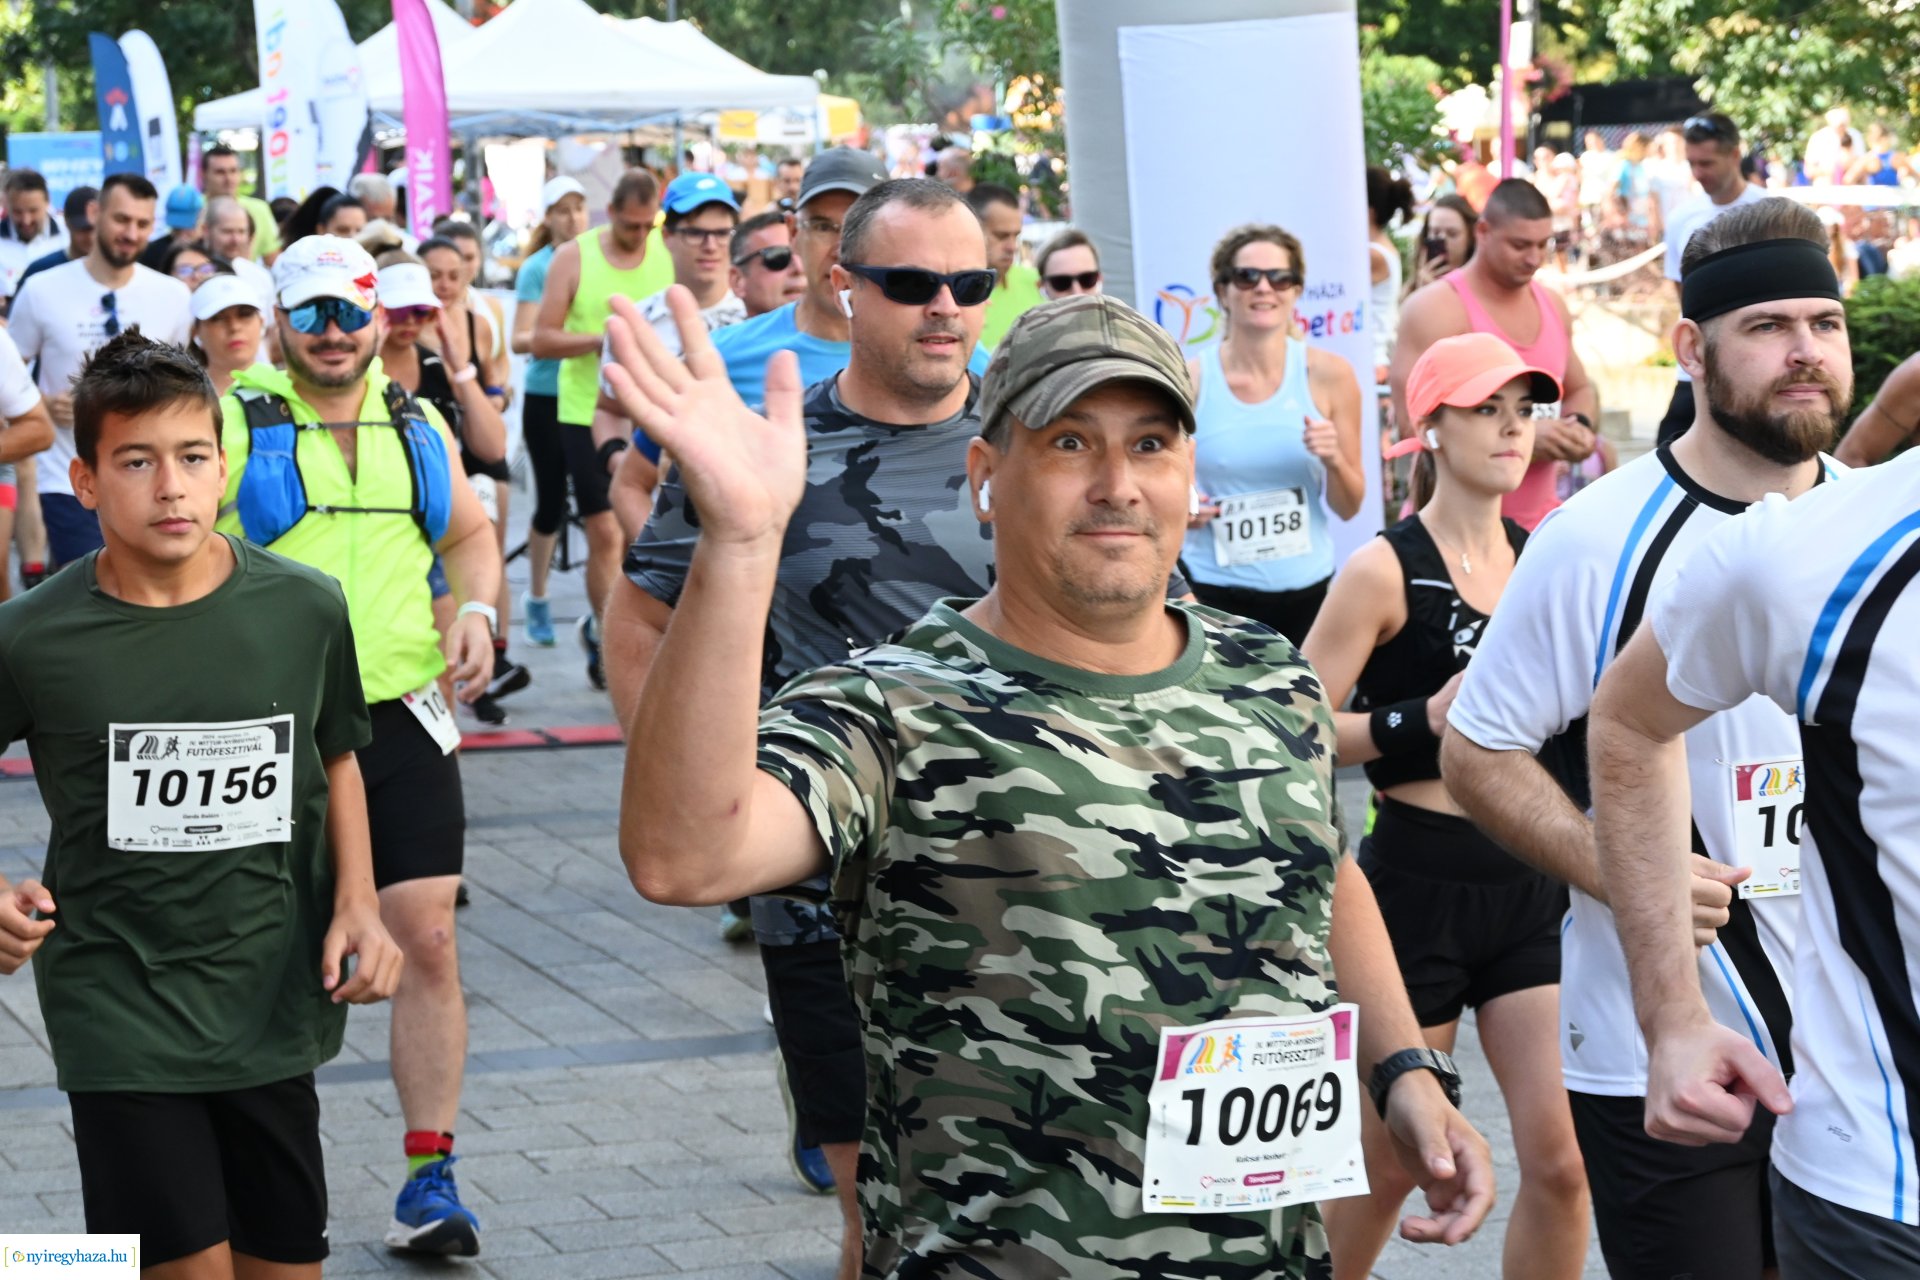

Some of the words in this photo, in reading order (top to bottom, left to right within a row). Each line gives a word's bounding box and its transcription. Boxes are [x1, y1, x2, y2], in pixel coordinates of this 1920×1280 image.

[1225, 511, 1301, 541] 10158
[186, 743, 263, 757] FUTÓFESZTIVÁL
[132, 761, 277, 807] 10156
[1181, 1072, 1341, 1146] 10069
